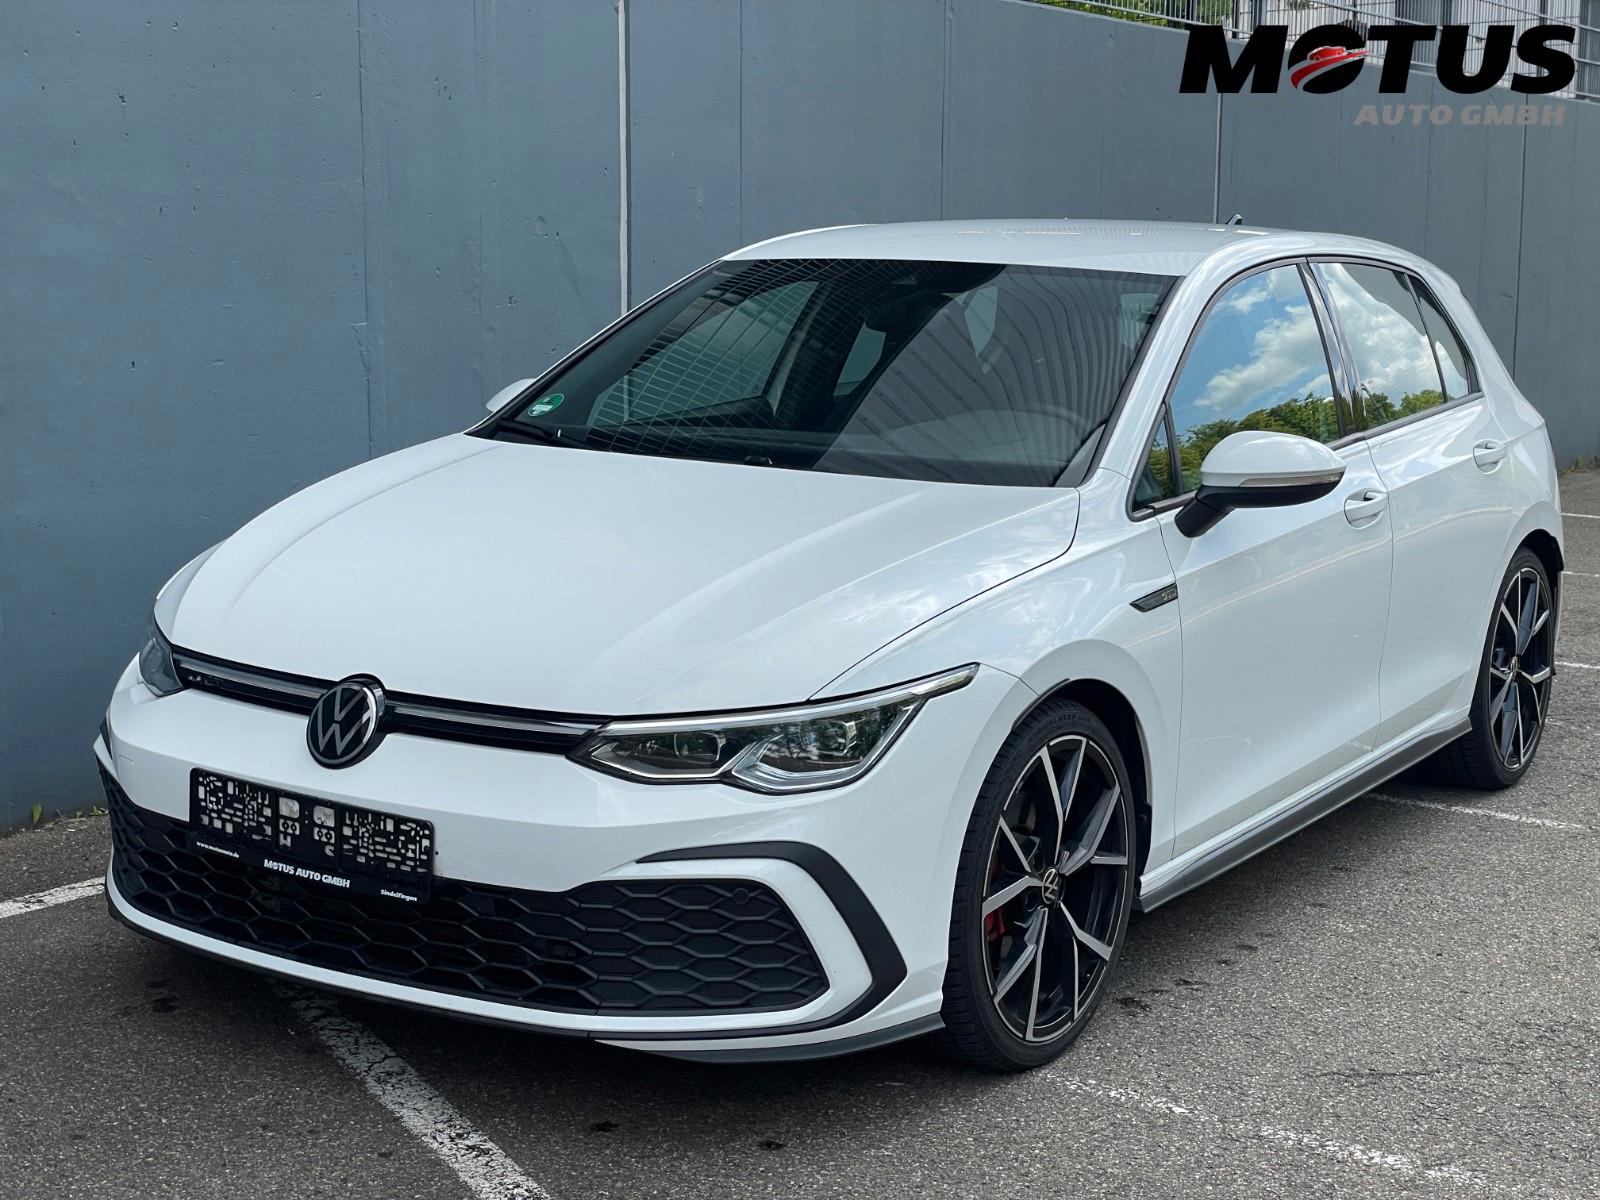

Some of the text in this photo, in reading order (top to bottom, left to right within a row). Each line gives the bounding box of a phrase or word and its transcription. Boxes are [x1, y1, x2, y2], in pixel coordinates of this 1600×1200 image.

[263, 858, 351, 888] MOTUS AUTO GMBH
[380, 889, 418, 902] Sindelfingen
